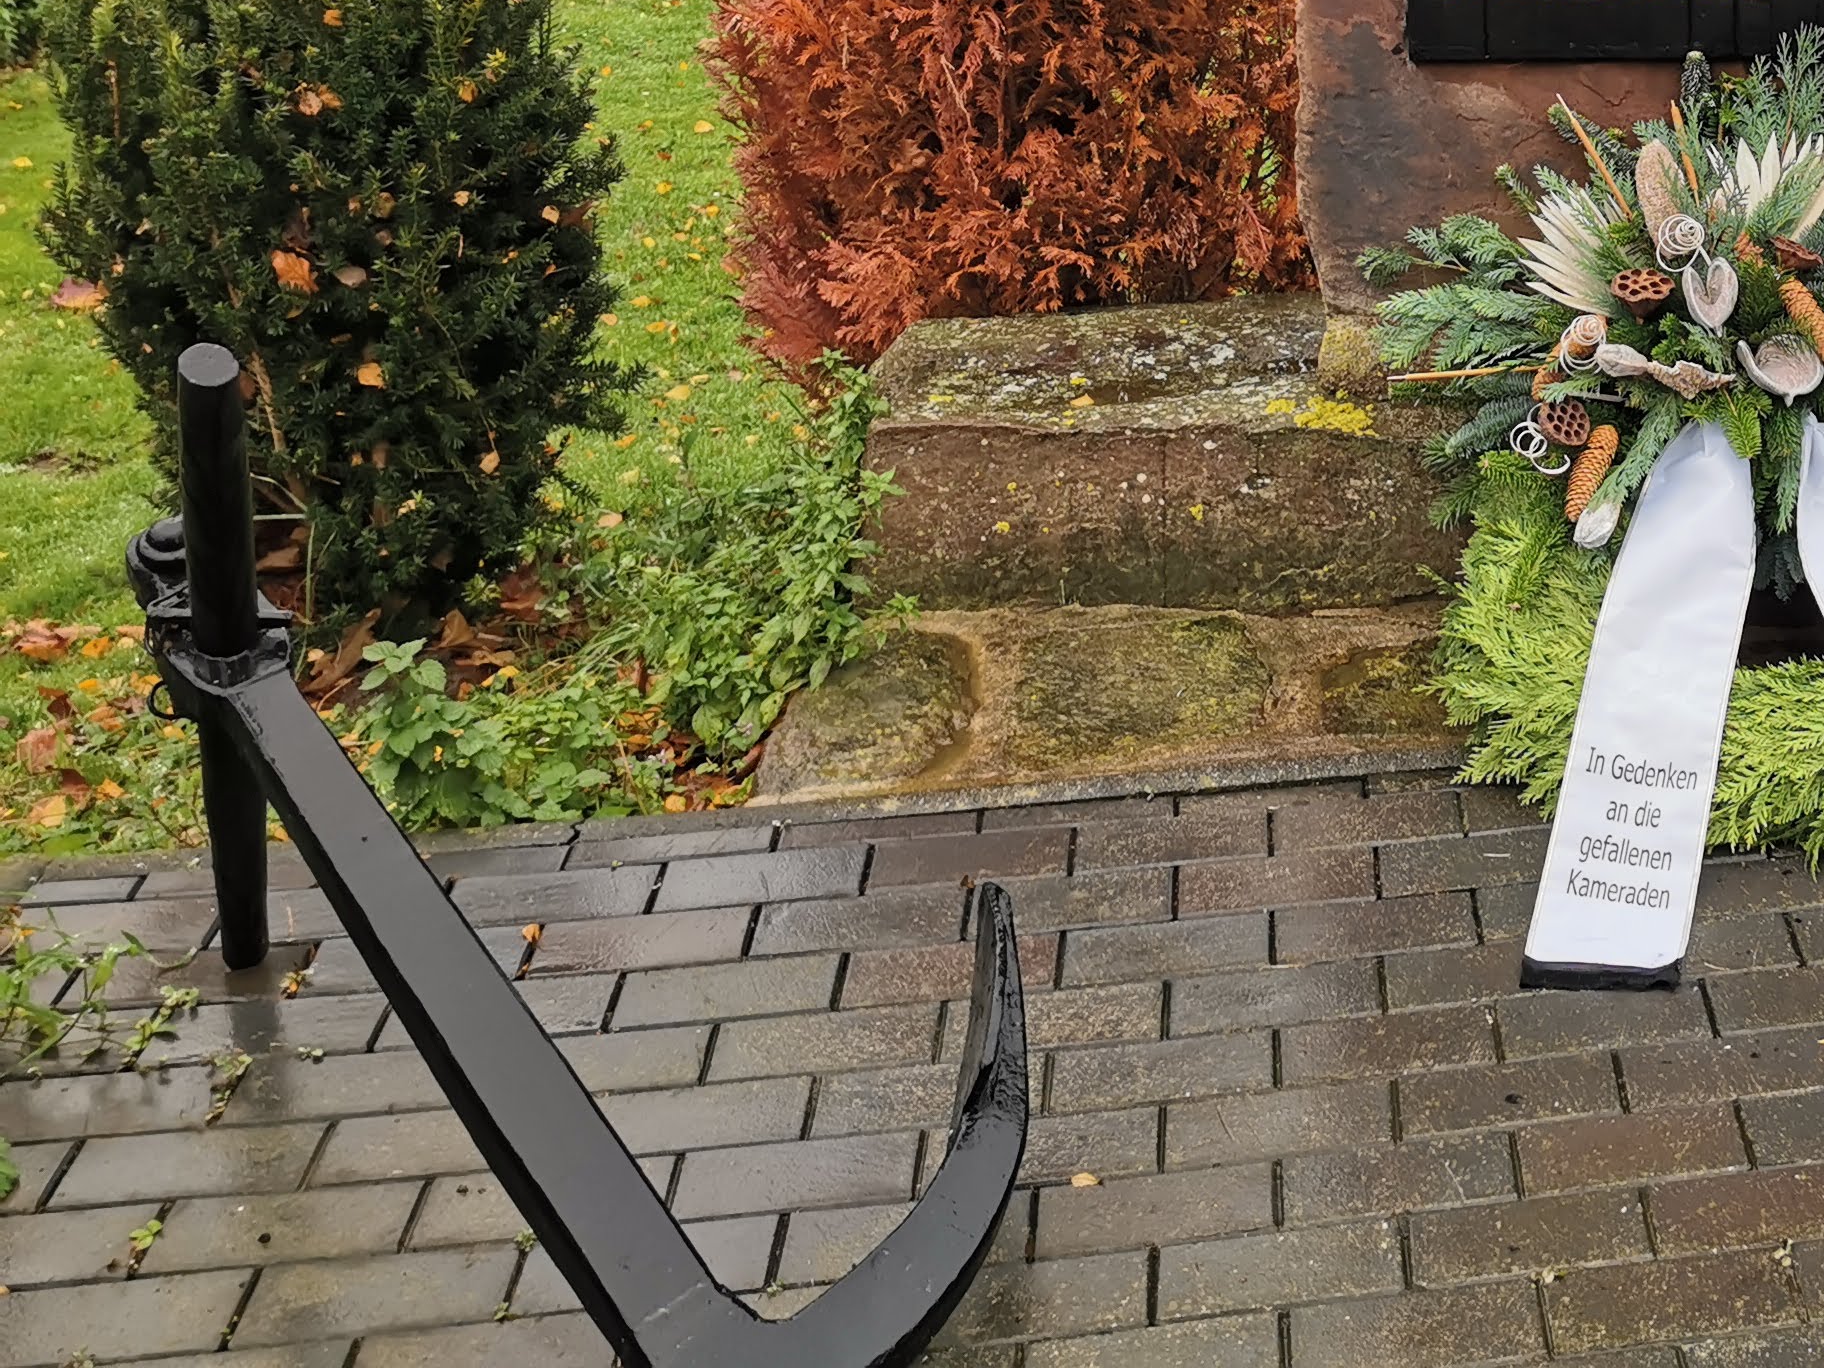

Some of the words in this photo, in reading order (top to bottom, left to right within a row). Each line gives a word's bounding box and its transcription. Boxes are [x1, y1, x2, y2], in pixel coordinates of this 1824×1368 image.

[1585, 746, 1605, 775] In
[1611, 754, 1698, 790] Gedenken
[1606, 800, 1628, 823] an
[1634, 800, 1661, 828] die
[1578, 835, 1672, 871] gefallenen
[1566, 868, 1670, 909] Kameraden
